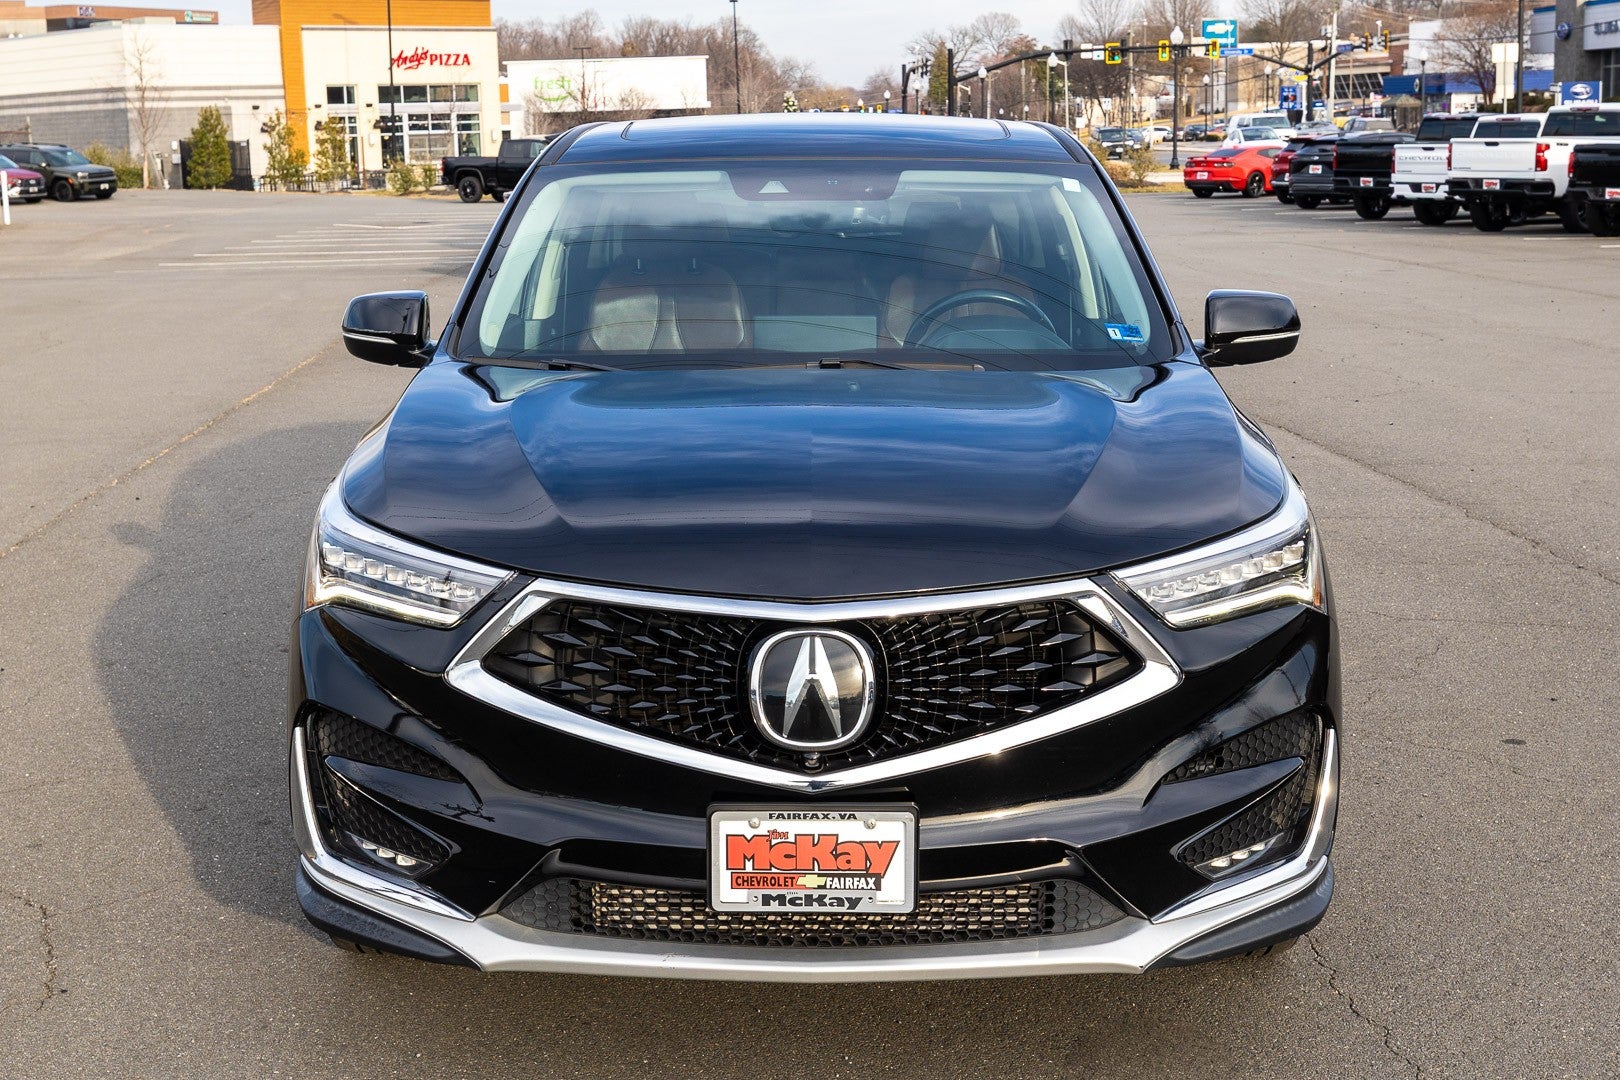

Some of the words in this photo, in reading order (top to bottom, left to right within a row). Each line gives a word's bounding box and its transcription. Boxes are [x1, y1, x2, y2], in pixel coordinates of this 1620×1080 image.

[429, 53, 471, 66] PIZZA
[534, 76, 571, 90] fresh
[838, 812, 858, 820] VA
[767, 829, 789, 842] Jim
[726, 834, 901, 878] McKay
[735, 876, 796, 888] CHEVROLET
[826, 877, 876, 890] FAIRFAX
[761, 893, 863, 911] McKay
